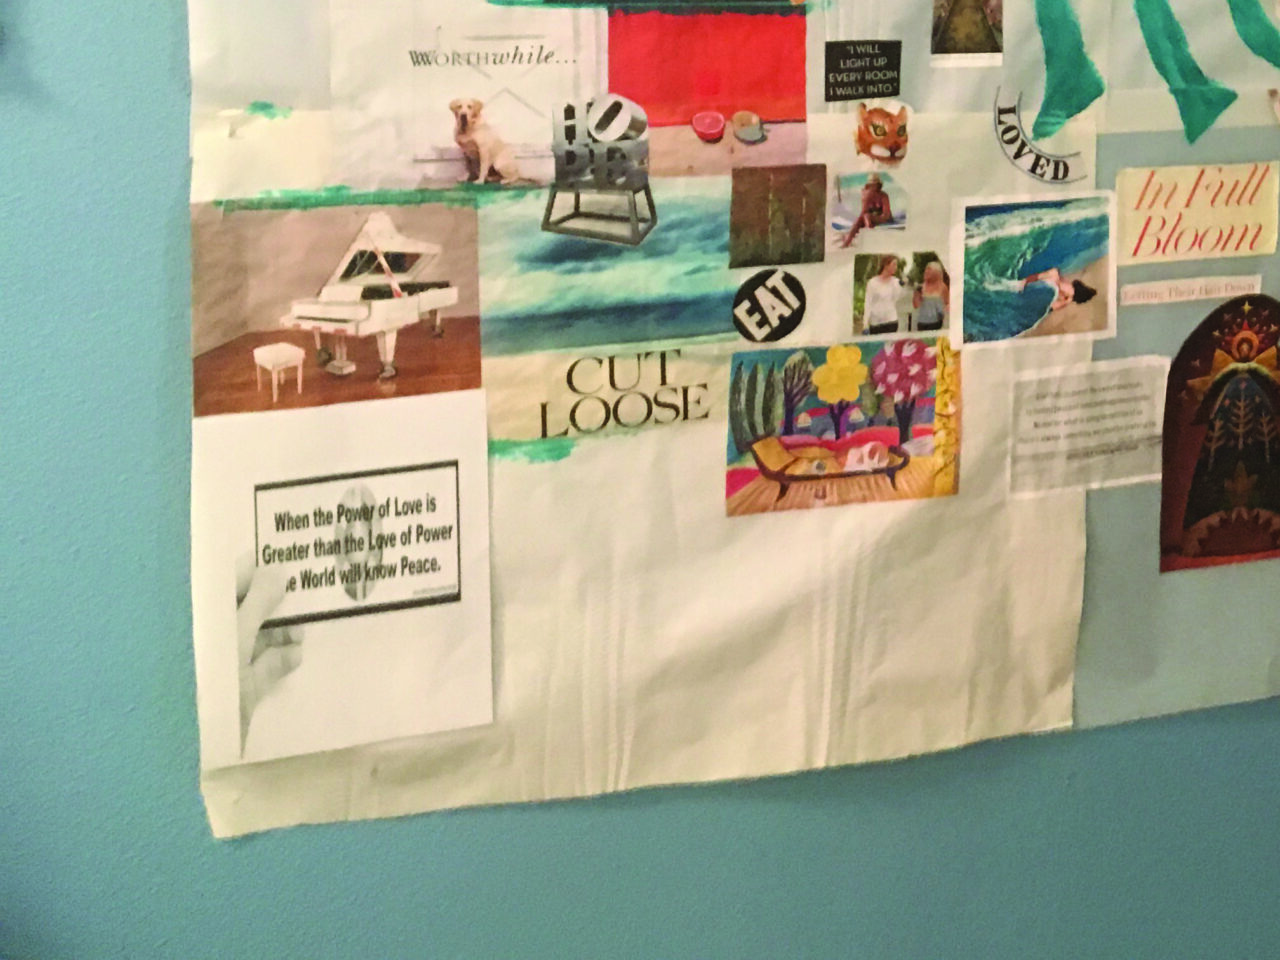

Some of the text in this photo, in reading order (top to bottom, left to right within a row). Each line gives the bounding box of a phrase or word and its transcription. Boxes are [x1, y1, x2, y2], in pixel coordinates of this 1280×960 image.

[840, 57, 888, 68] LIGHT UP
[856, 44, 880, 53] WILL
[828, 70, 898, 83] EVERY ROOM
[835, 85, 864, 96] WALK
[998, 105, 1069, 180] LOVED
[1134, 163, 1270, 211] In Full
[1132, 212, 1262, 257] Bloom
[734, 270, 801, 341] EAT
[566, 348, 681, 395] CUT
[540, 383, 709, 439] LOOSE
[274, 493, 437, 532] When the Power of Love is
[262, 524, 453, 565] Greater than the Love of Power
[300, 567, 336, 590] World
[339, 562, 361, 584] will
[364, 562, 397, 582] know
[400, 556, 441, 577] Peace.
